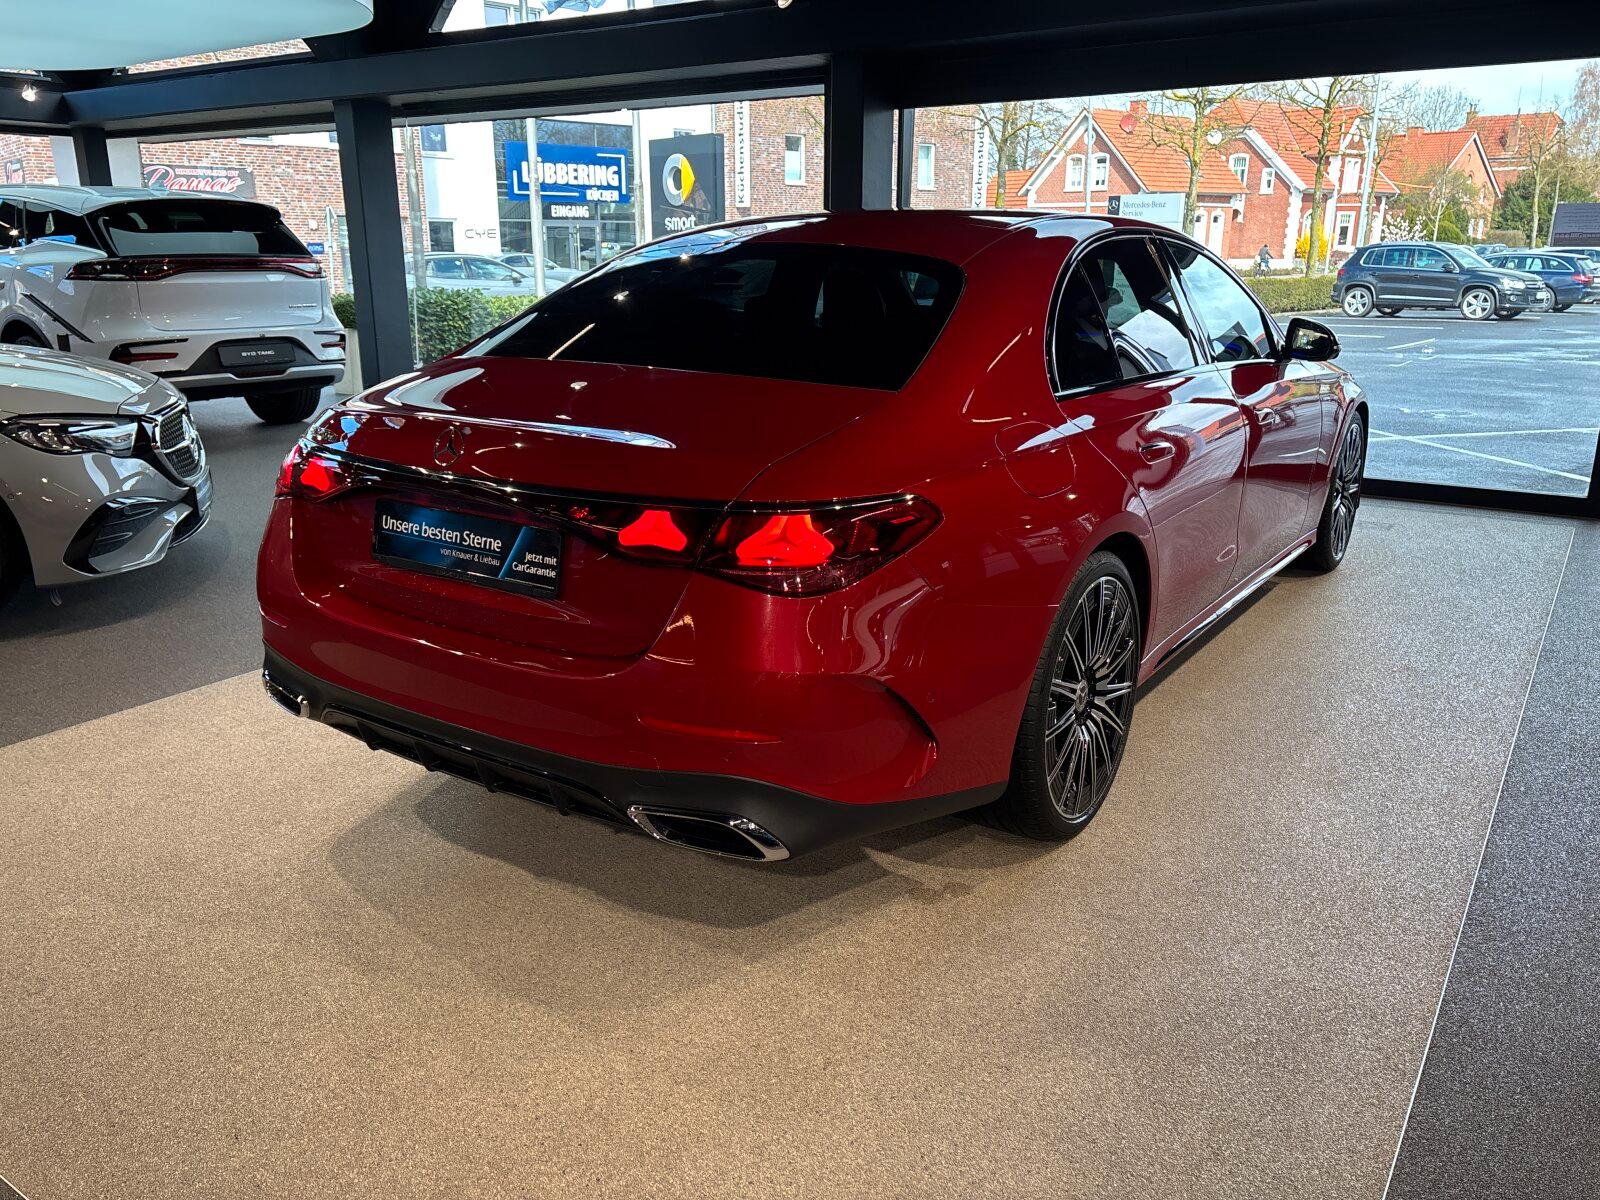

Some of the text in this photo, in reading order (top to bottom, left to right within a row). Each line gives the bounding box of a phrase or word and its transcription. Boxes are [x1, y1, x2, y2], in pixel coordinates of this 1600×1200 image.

[973, 121, 985, 208] Küchenstud
[550, 204, 590, 218] EINGANG
[1122, 200, 1167, 209] Mercedes-Benz
[664, 214, 697, 231] smart
[382, 514, 502, 552] Unsere besten Sterne
[440, 548, 500, 566] von Knauer & Liebau
[524, 551, 557, 566] Jetzt mit
[512, 561, 557, 579] CarGarantie
